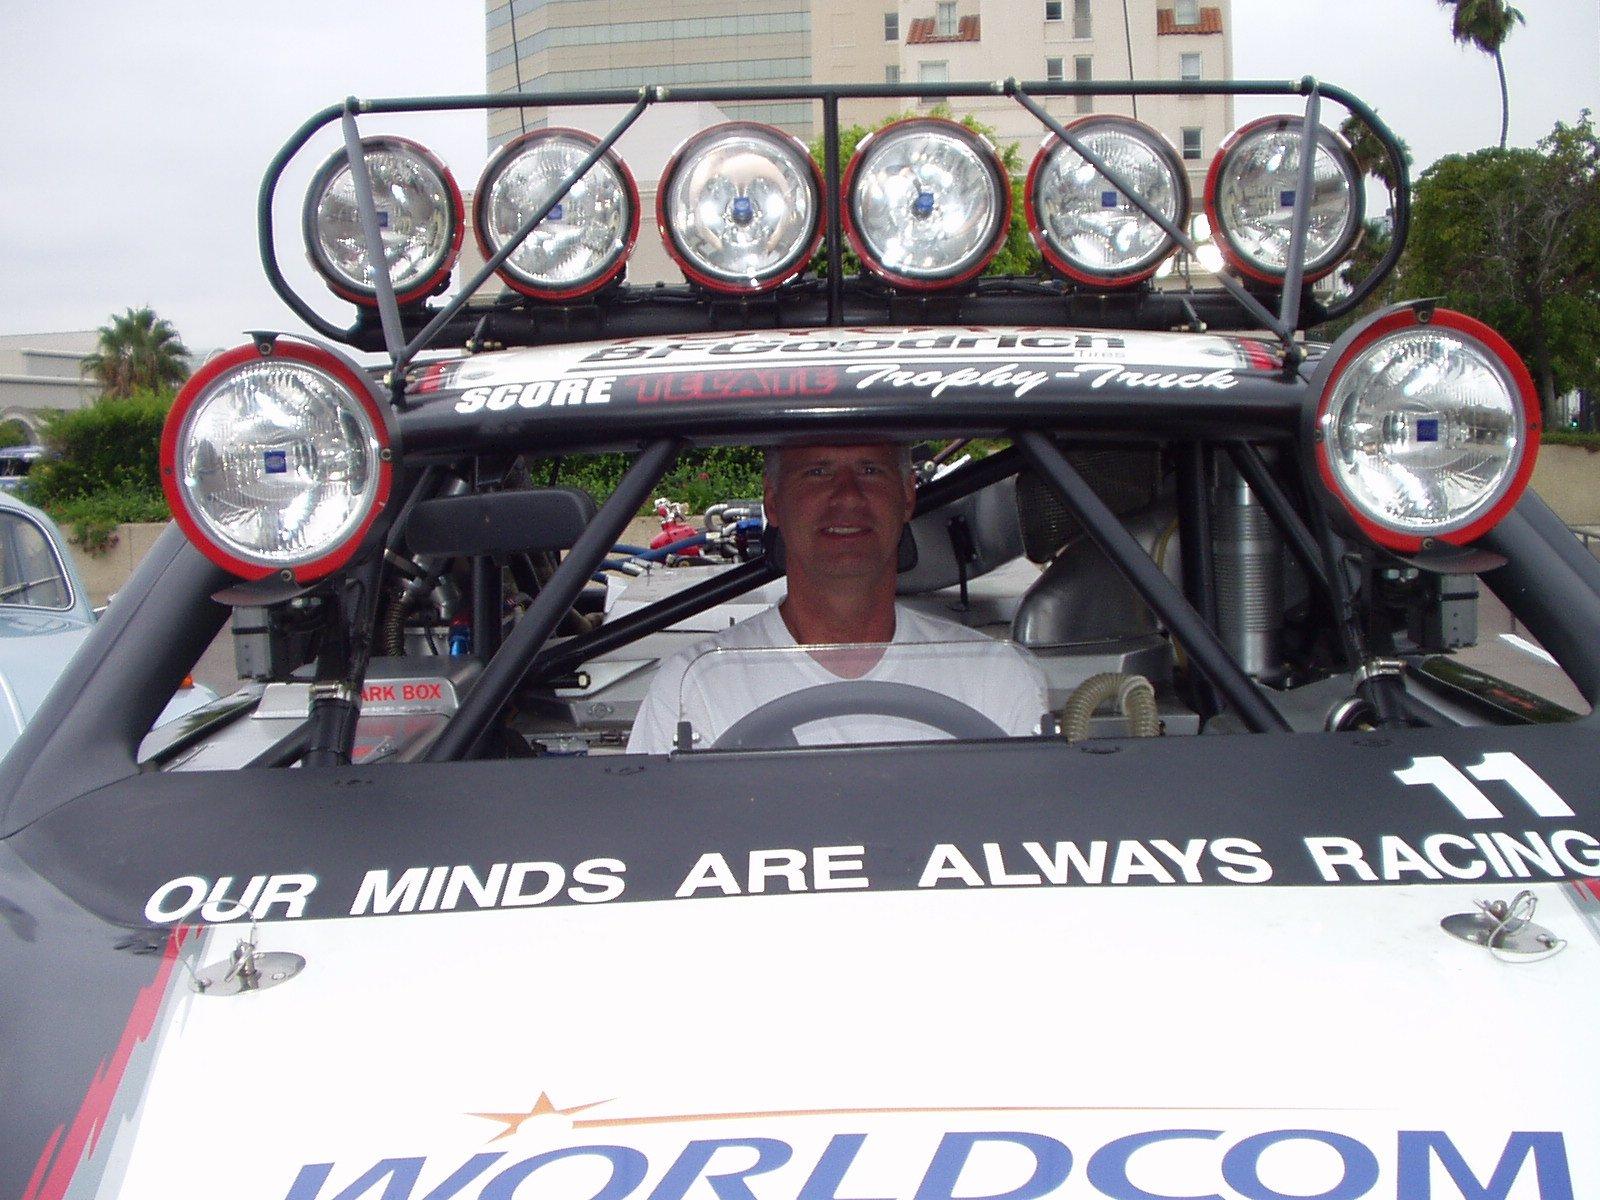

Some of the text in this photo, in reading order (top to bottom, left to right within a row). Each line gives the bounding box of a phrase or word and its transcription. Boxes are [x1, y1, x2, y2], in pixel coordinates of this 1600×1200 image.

[578, 334, 1126, 363] BFGoodrich
[1077, 349, 1126, 360] Tires
[455, 376, 617, 413] SCORE
[845, 362, 1239, 398] Trophy-Truck
[402, 683, 442, 701] BOX
[1393, 751, 1576, 820] 11
[144, 829, 1600, 924] OUR MINDS ARE ALWAYS RACING
[283, 1128, 1574, 1200] WORLDCOM
